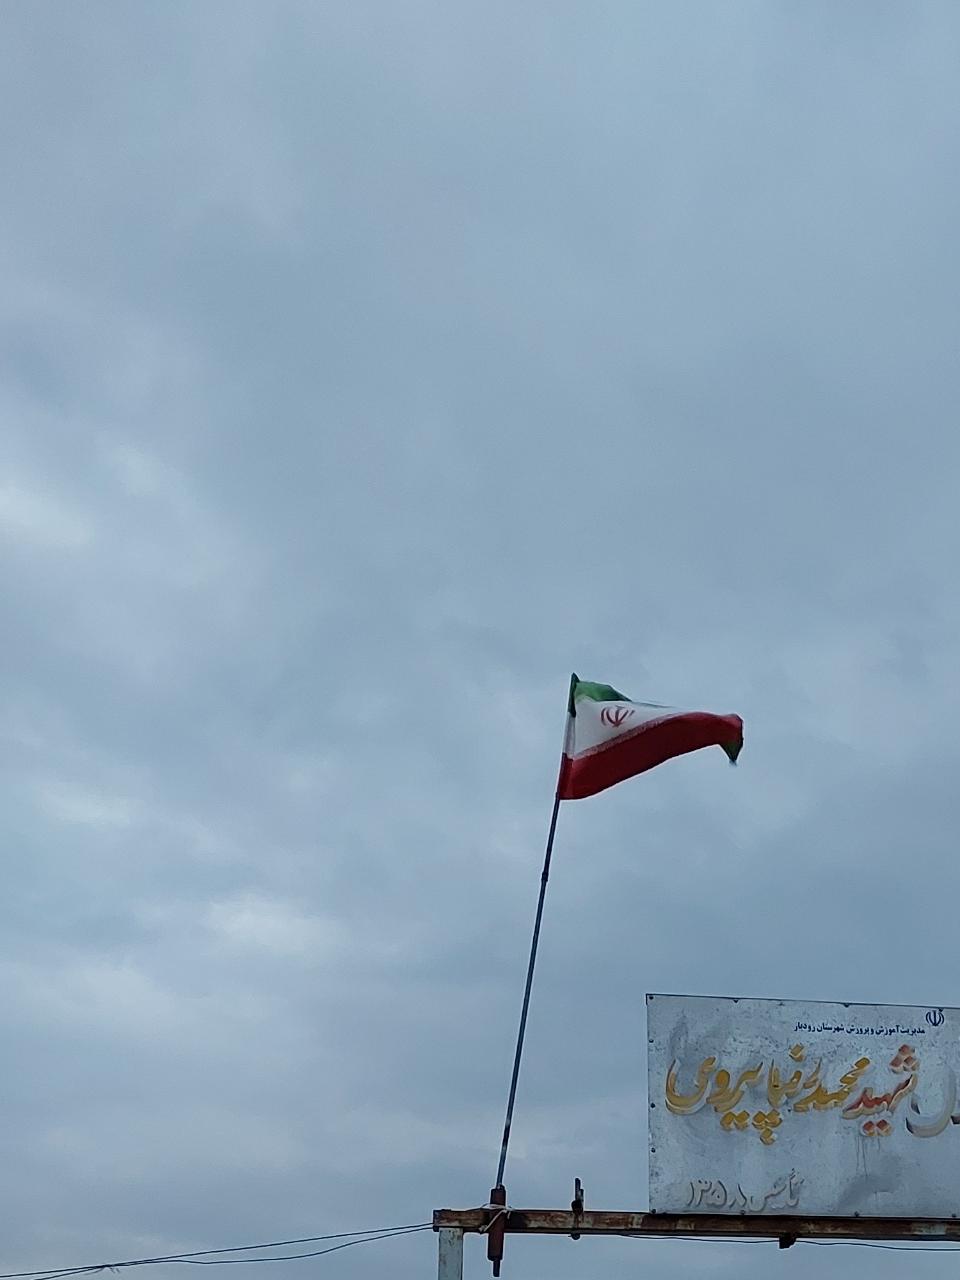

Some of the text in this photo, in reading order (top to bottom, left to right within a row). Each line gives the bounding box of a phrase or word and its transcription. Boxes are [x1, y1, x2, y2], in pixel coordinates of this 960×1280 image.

[793, 1021, 816, 1032] رودبار
[816, 1022, 845, 1034] شهرستان
[875, 1024, 900, 1036] آموزش
[899, 1025, 926, 1036] مدیریت
[841, 1044, 918, 1137] شهید
